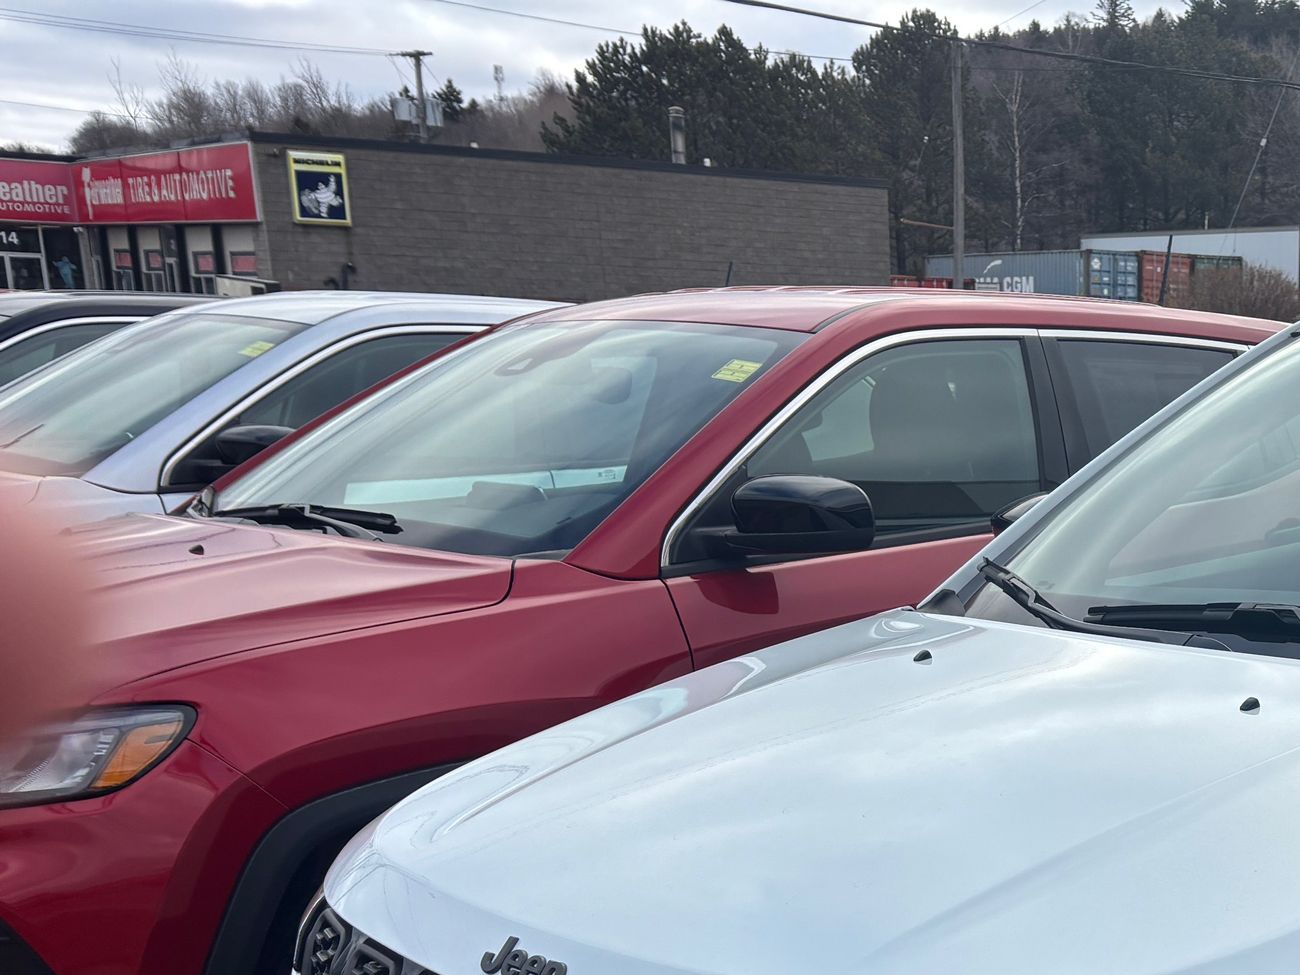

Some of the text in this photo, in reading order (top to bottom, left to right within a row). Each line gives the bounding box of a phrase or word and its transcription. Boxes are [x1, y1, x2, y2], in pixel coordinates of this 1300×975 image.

[128, 175, 151, 203] TIRE
[151, 175, 159, 203] &
[160, 168, 236, 201] AUTOMOTIVE
[1003, 276, 1034, 293] CGM
